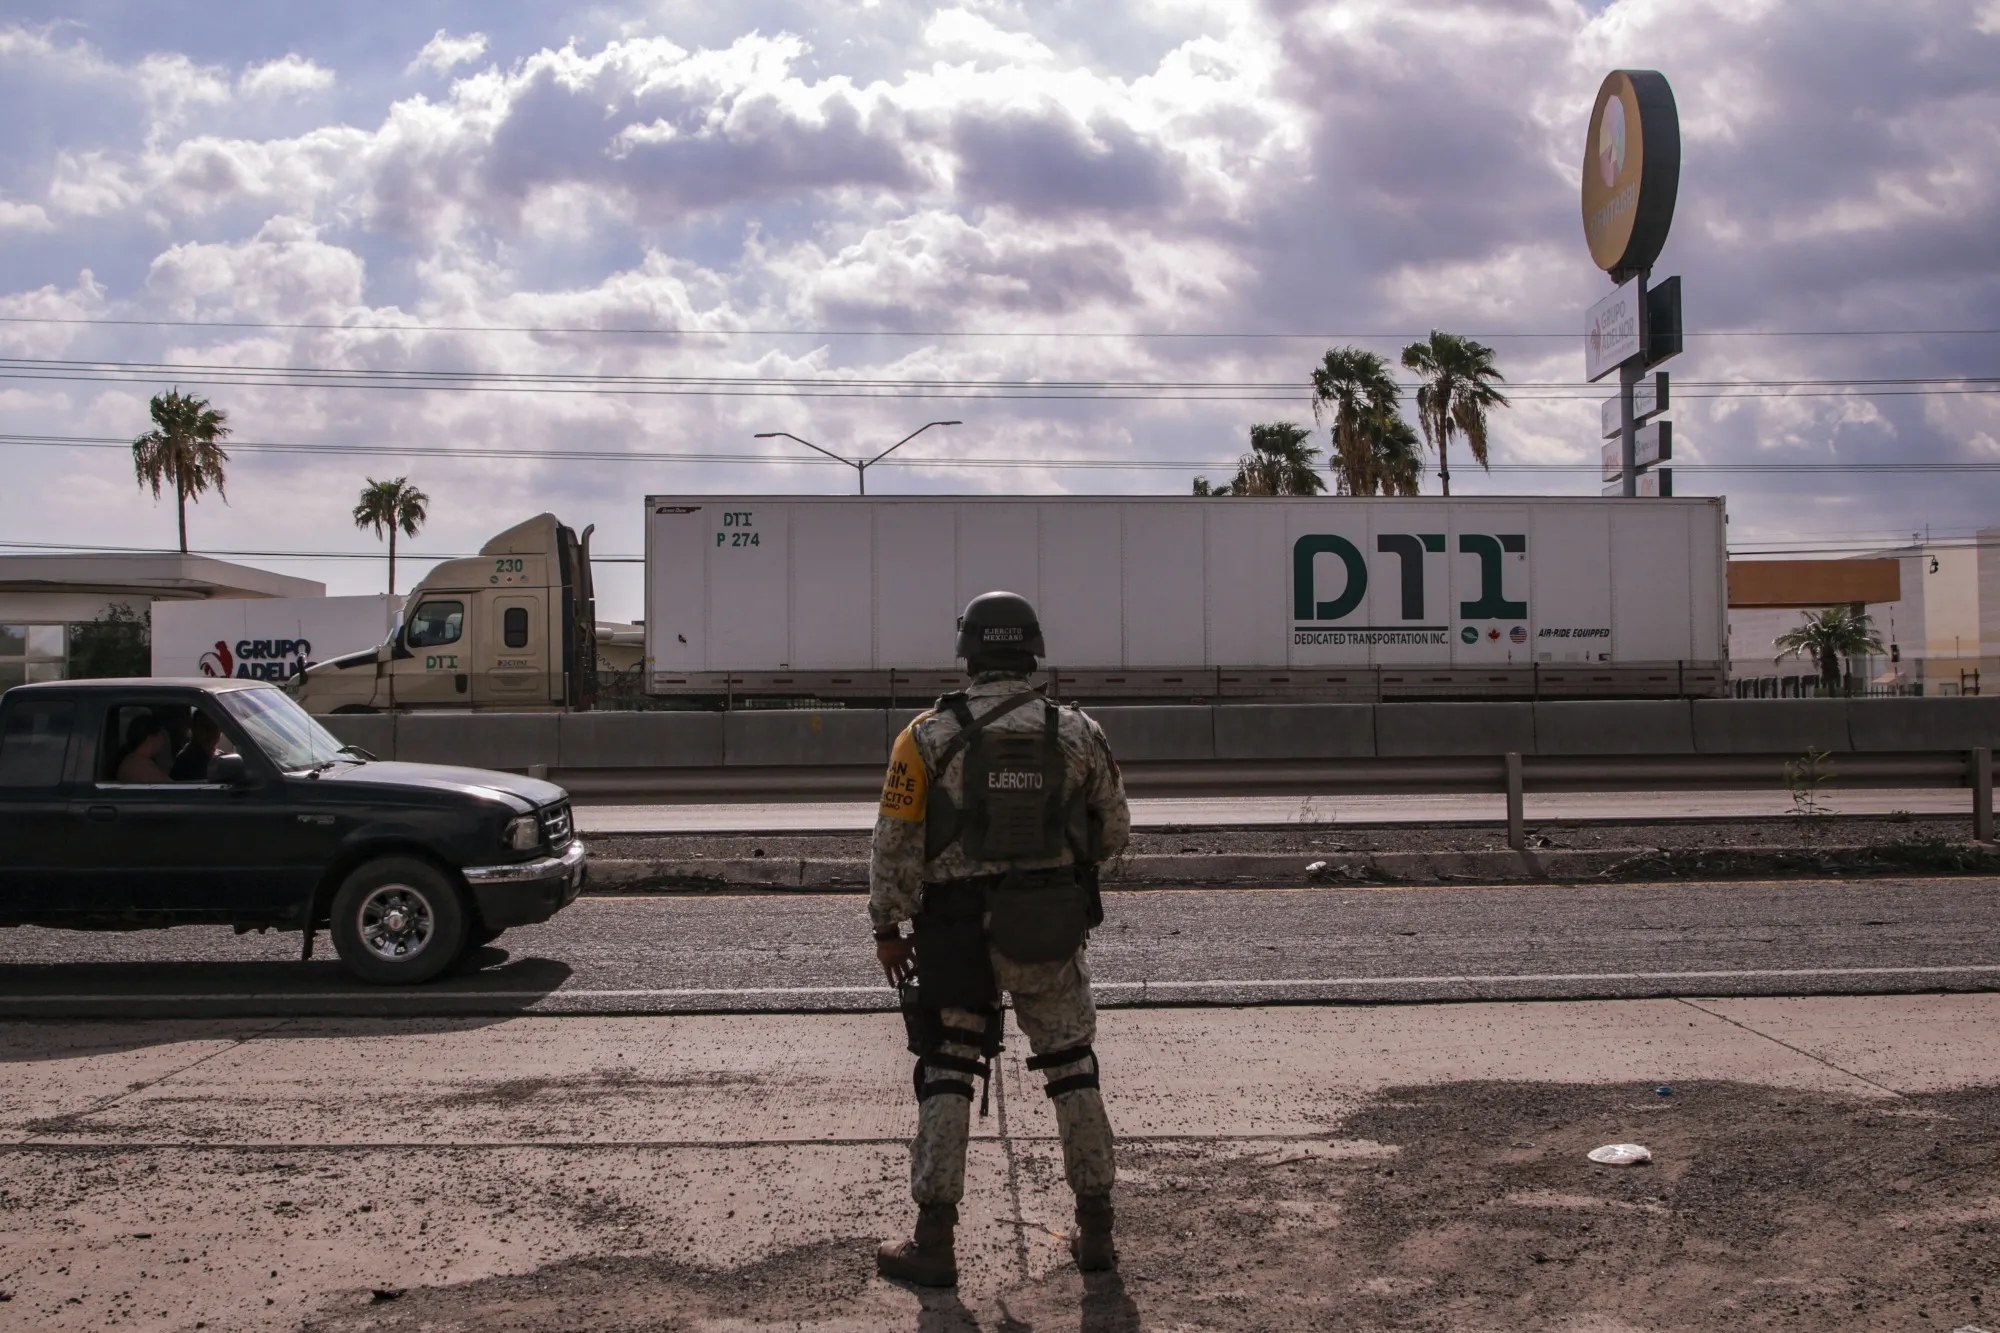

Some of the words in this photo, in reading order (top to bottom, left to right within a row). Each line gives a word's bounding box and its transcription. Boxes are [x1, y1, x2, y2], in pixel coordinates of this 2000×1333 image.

[1601, 300, 1626, 329] GRUPO
[1601, 317, 1634, 353] ADELNOR
[723, 512, 752, 527] DTI
[716, 532, 726, 547] P
[731, 532, 760, 547] 274
[495, 558, 523, 573] 230
[1293, 534, 1528, 620] DTI
[1294, 633, 1346, 645] DEDICATED
[1347, 633, 1427, 645] TRANSPORTATION
[1430, 633, 1448, 645] INC.
[1572, 628, 1610, 638] EQUIPPED
[235, 639, 311, 660] GRUPO
[426, 655, 458, 669] DTI
[236, 661, 318, 681] ADELN
[889, 760, 908, 776] AN
[888, 774, 916, 792] III-E
[988, 767, 1043, 789] EJÉRCITO
[884, 790, 914, 806] CITO
